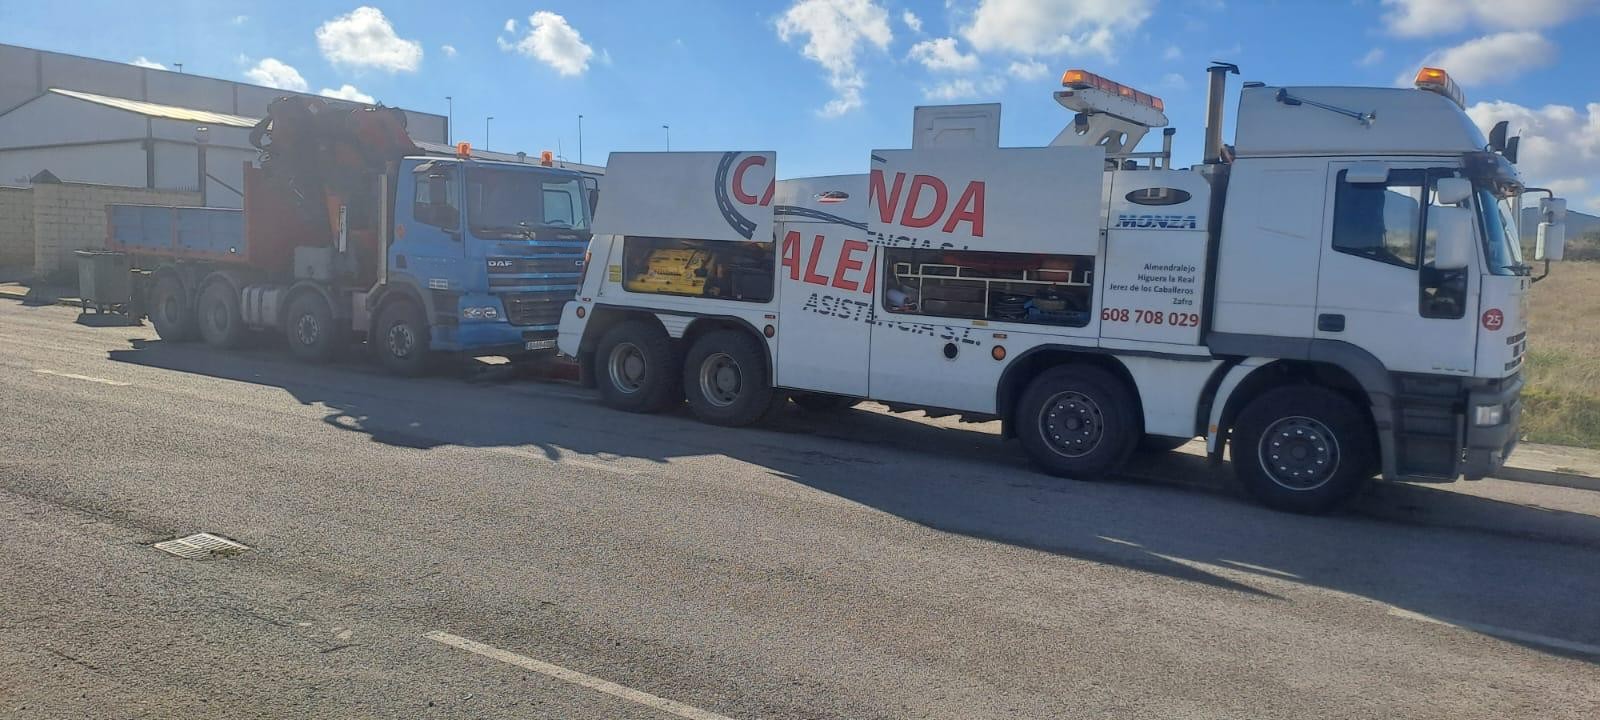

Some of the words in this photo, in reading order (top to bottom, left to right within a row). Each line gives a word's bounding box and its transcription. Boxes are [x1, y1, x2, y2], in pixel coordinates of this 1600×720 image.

[1115, 214, 1197, 229] MONZA
[1144, 263, 1196, 273] Almendralejo
[1137, 273, 1168, 283] Higuera
[1169, 274, 1176, 282] la
[1178, 275, 1195, 284] Real
[1109, 283, 1128, 291] Jerez
[1141, 284, 1151, 292] los
[1154, 285, 1194, 295] Caballeros
[1102, 307, 1130, 322] 608
[1135, 309, 1164, 325] 708
[1168, 312, 1200, 327] 029
[1486, 314, 1501, 326] 25
